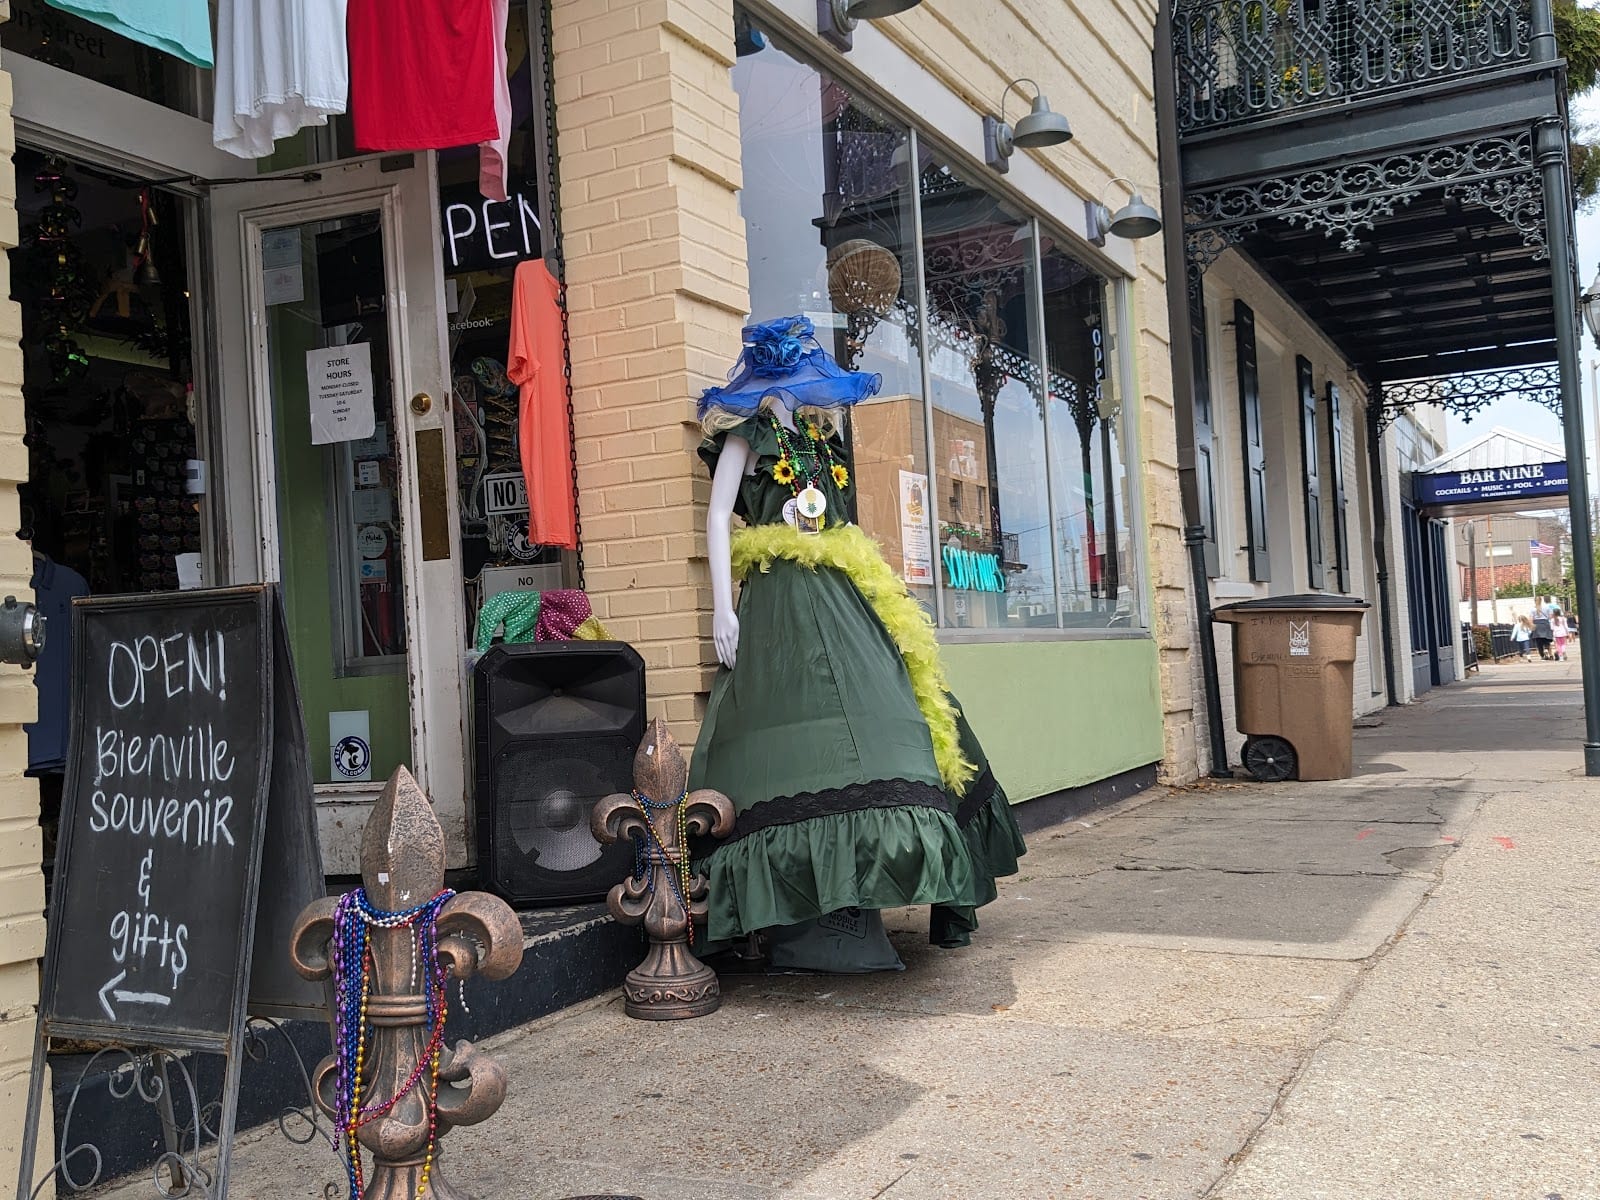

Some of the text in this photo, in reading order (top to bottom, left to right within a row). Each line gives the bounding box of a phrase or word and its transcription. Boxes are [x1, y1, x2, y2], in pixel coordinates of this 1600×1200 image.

[442, 192, 541, 267] PEN
[327, 357, 350, 368] STORE
[326, 369, 352, 380] HOURS
[1459, 465, 1544, 485] BAR NINE
[493, 480, 517, 507] NO
[1435, 487, 1472, 497] COCKTAILS
[1481, 484, 1504, 492] MUSIC
[1513, 481, 1534, 489] POOL
[511, 545, 538, 558] WELCOME
[943, 545, 1005, 593] SOUVENIRS
[518, 577, 534, 586] NO
[108, 630, 227, 708] OPEN!
[96, 724, 235, 783] Bienville
[339, 764, 366, 776] WELCOME
[137, 848, 154, 907] &
[110, 909, 189, 990] gifts
